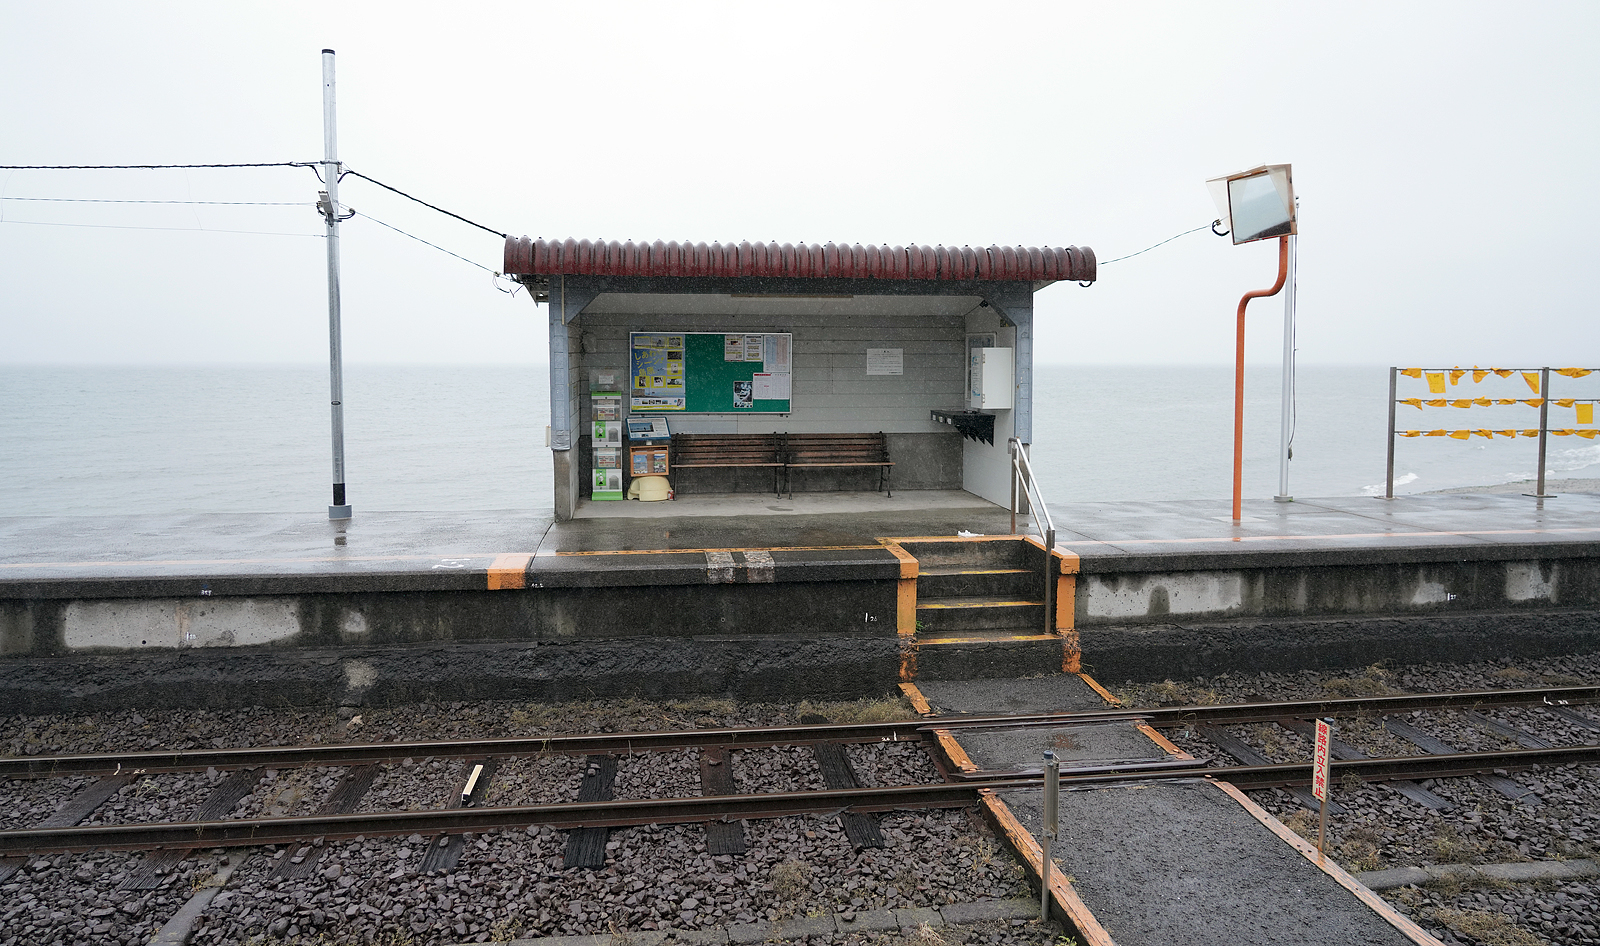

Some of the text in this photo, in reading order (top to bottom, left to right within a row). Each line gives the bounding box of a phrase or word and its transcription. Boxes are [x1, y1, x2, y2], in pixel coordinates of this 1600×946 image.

[1314, 722, 1328, 799] 線路内立入禁止
